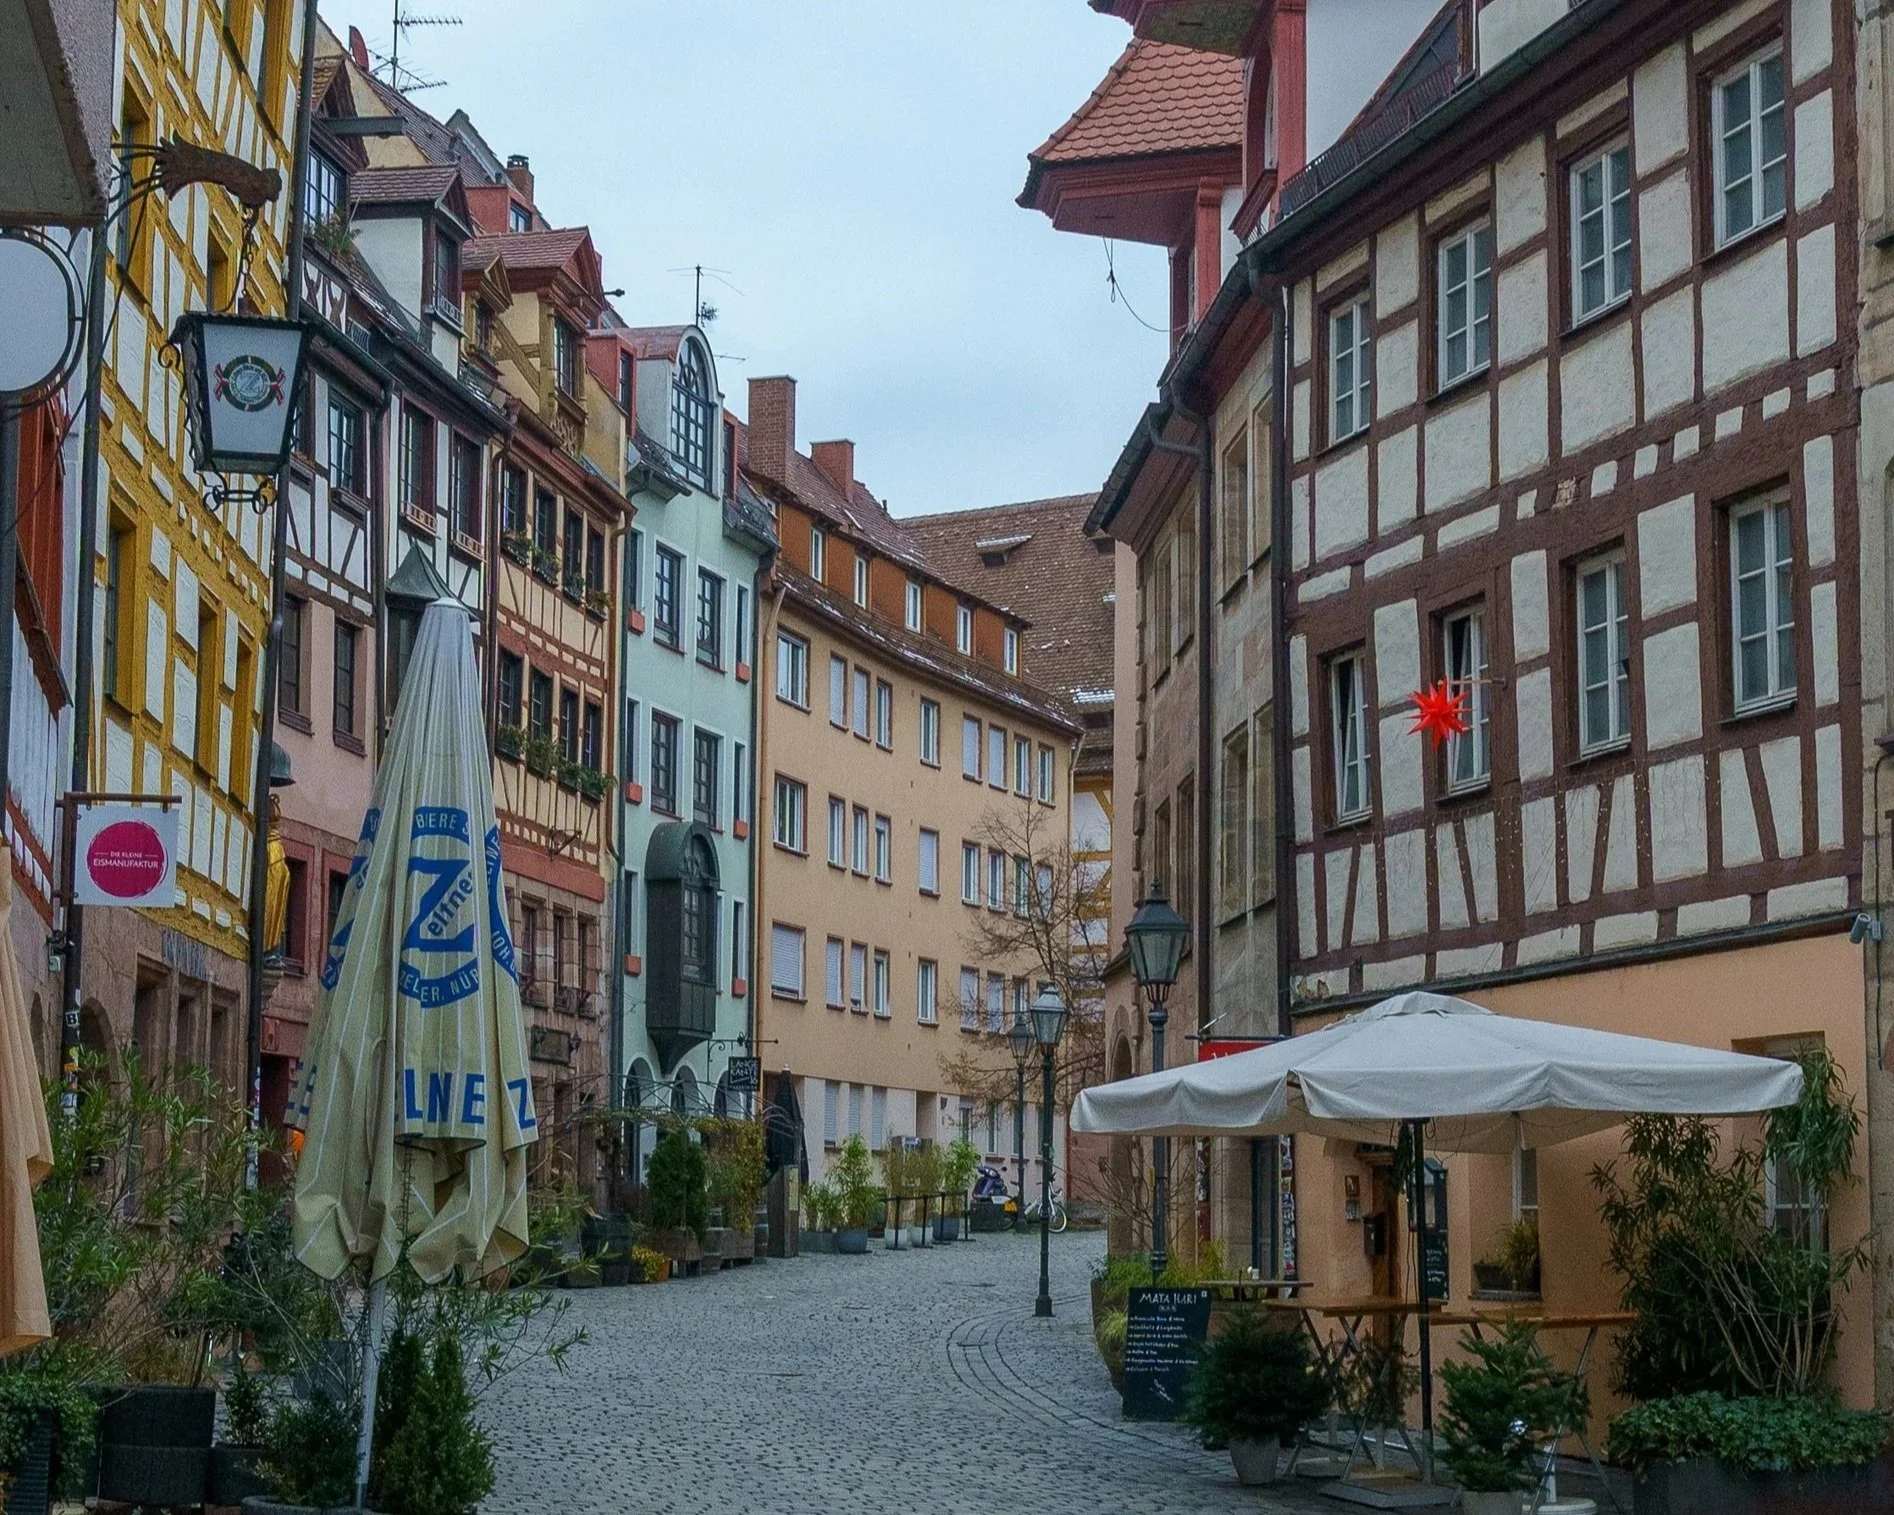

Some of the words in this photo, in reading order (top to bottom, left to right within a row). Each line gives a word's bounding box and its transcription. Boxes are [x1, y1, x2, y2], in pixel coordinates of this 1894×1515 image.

[415, 812, 458, 829] BIERE
[122, 851, 142, 859] KLEINE
[93, 858, 159, 869] EISMANUFAKTUR
[1139, 1292, 1170, 1304] MATA
[1173, 1292, 1197, 1305] HARI
